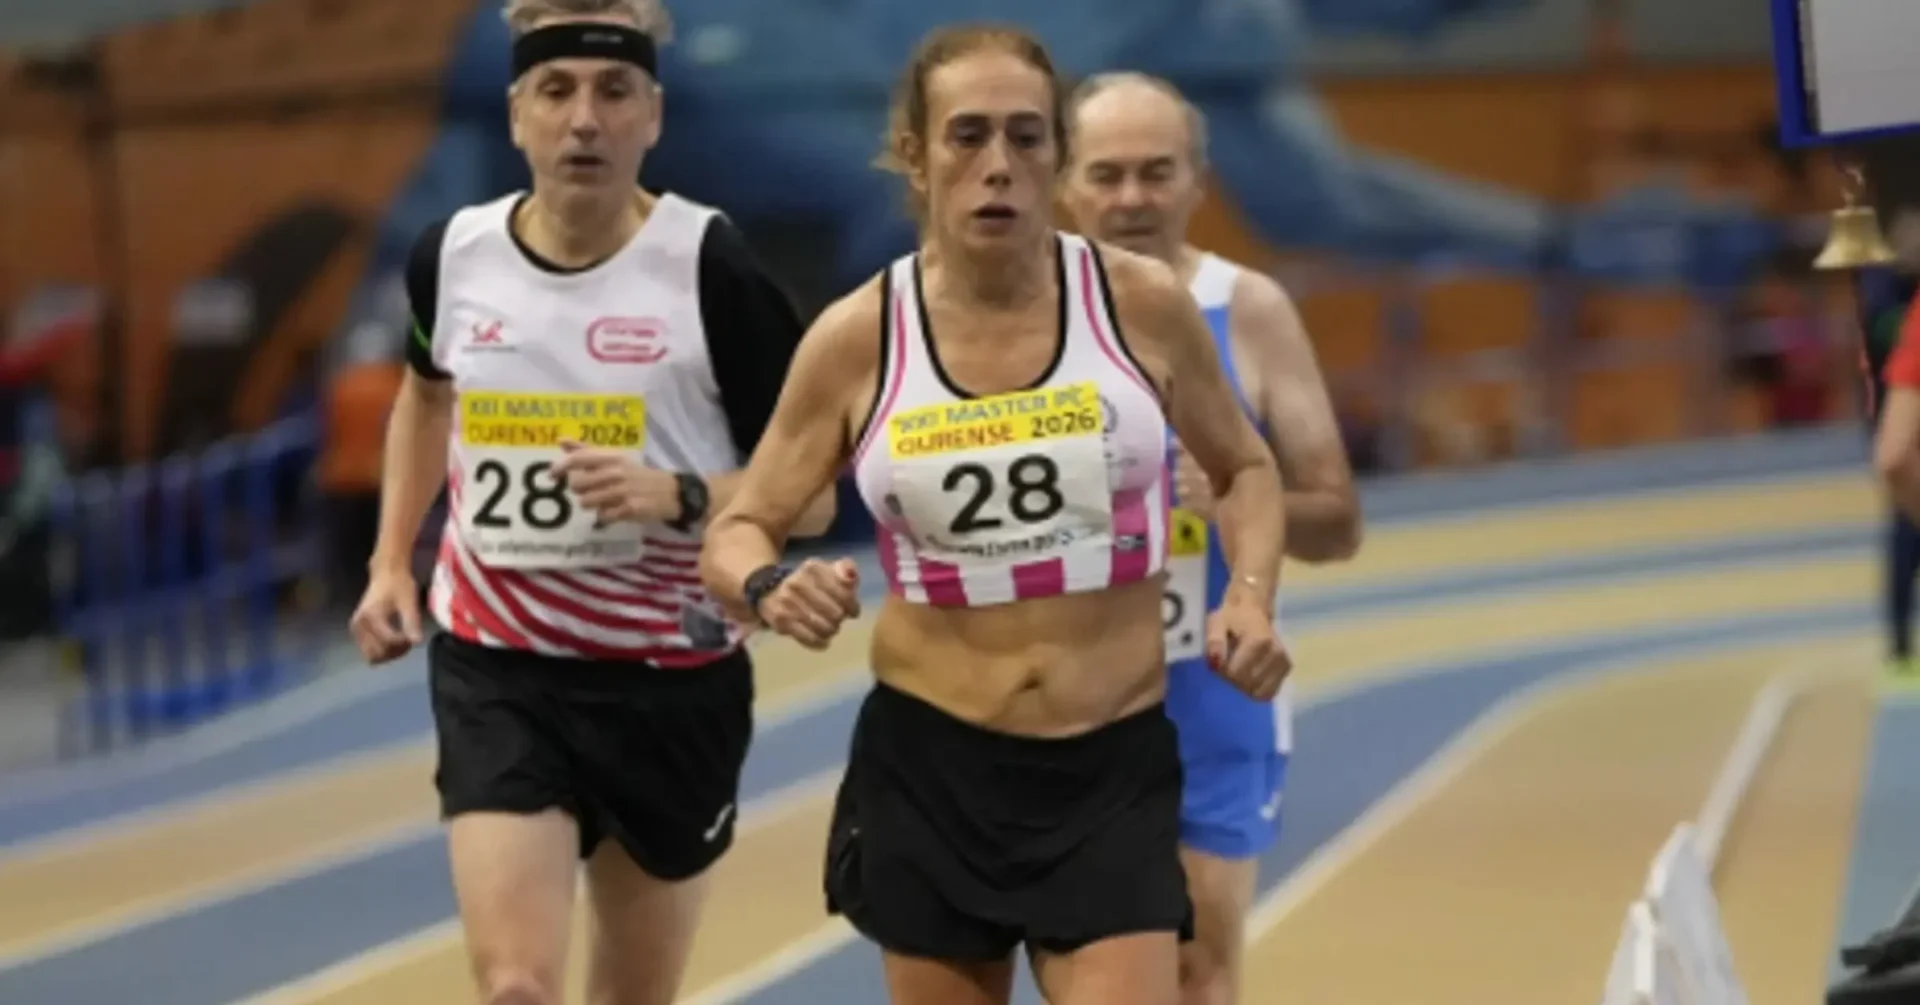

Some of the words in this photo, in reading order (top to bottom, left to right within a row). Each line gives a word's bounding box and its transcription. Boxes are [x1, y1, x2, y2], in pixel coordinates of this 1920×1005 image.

[505, 398, 596, 420] MASTER
[945, 395, 1048, 423] MASTER
[578, 424, 640, 447] 2026
[896, 421, 1016, 455] OURENSE
[942, 453, 1065, 533] 28
